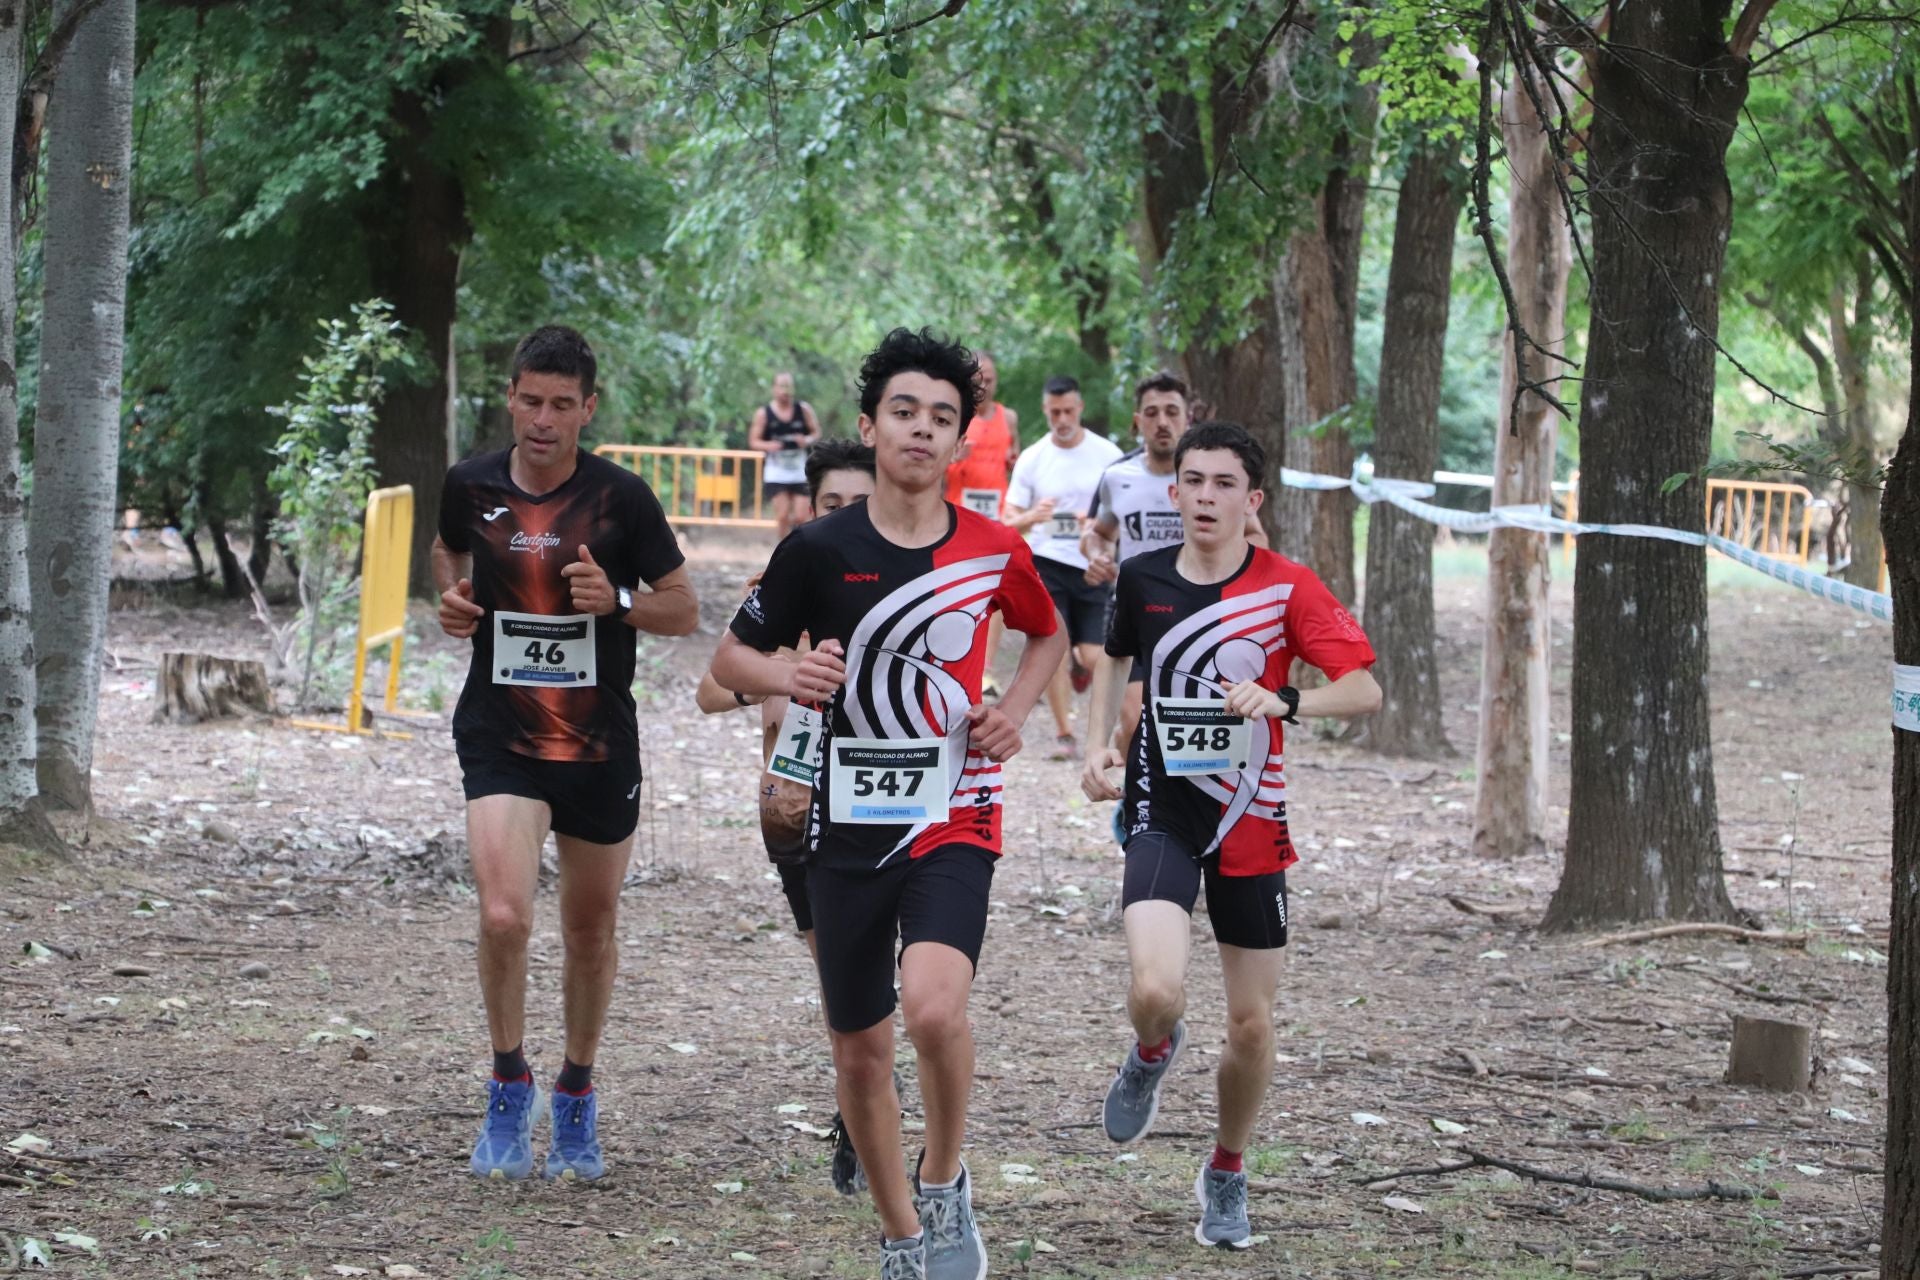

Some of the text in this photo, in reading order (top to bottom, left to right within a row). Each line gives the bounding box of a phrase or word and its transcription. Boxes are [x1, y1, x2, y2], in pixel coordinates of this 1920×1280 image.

[524, 641, 565, 665] 46
[1166, 727, 1231, 752] 548
[853, 769, 924, 797] 547
[972, 785, 994, 842] club
[1272, 800, 1291, 861] club
